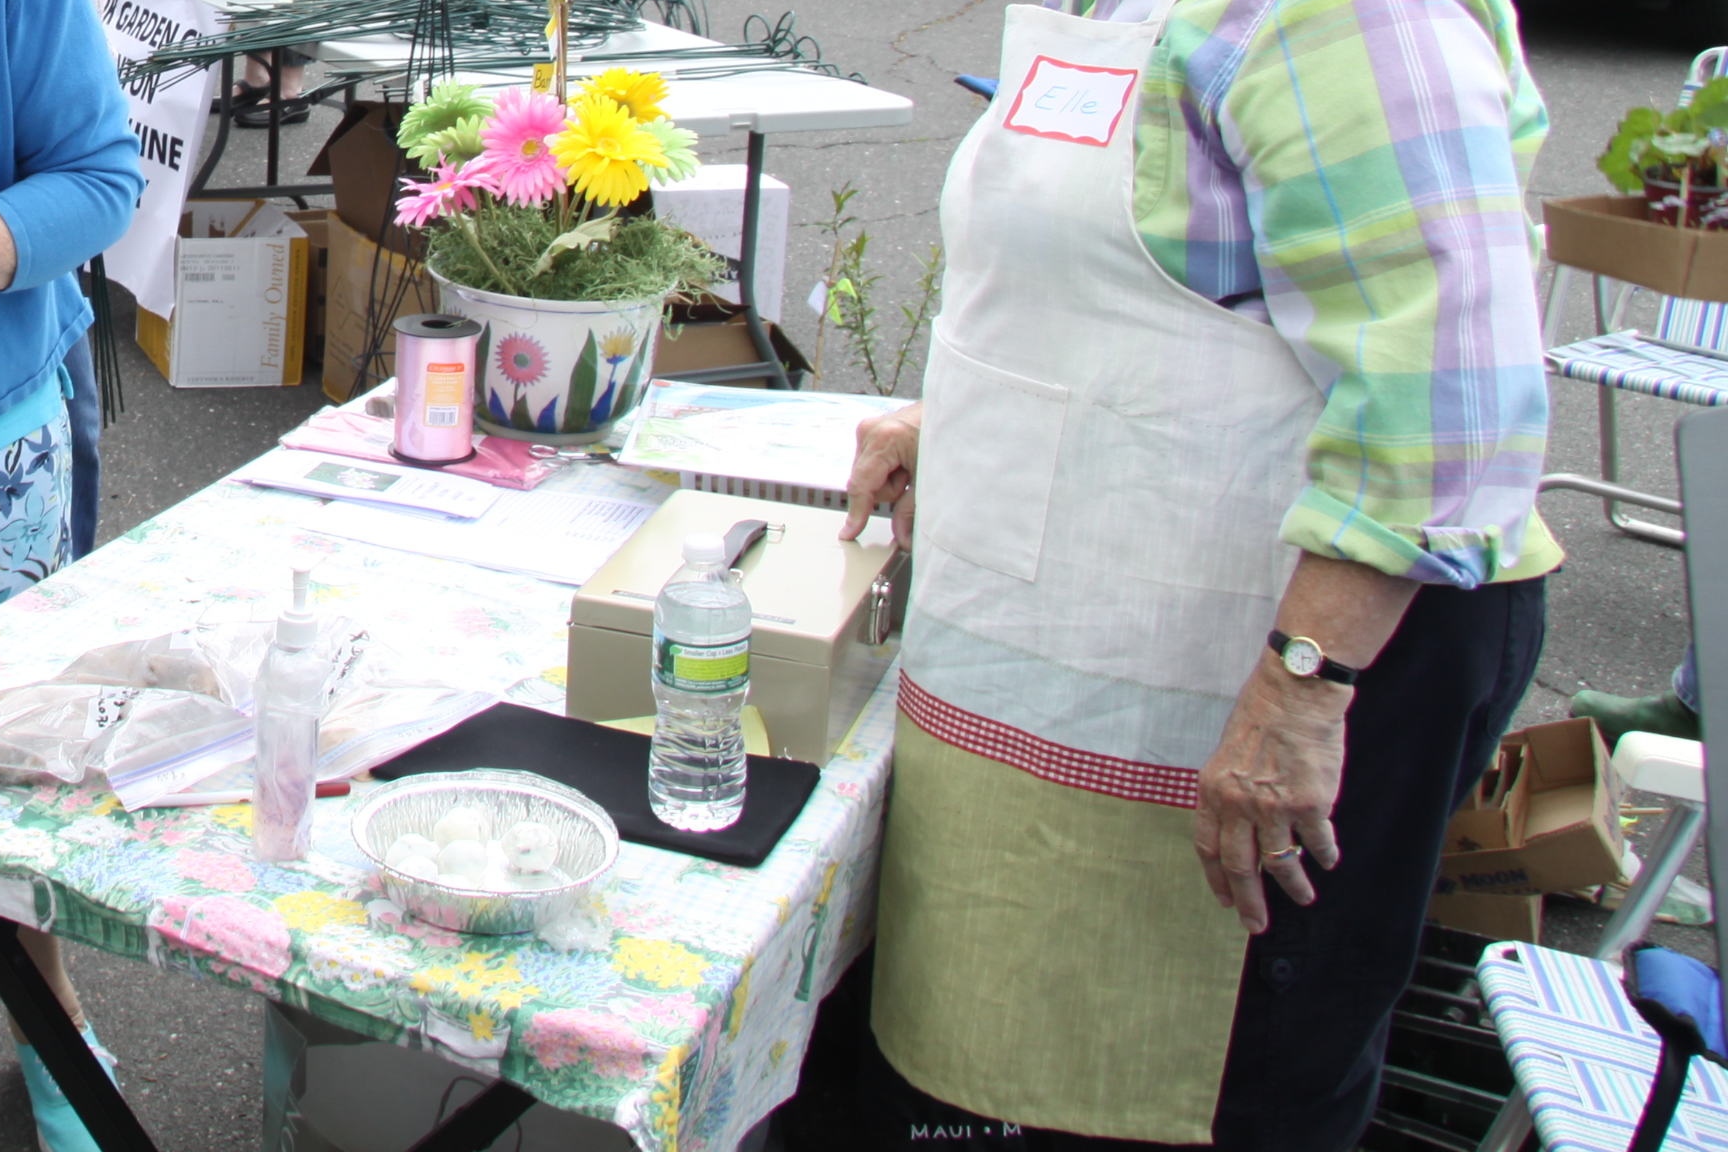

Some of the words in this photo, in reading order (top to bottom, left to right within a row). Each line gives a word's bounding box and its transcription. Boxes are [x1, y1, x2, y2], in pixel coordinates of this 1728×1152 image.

[115, 0, 180, 49] GARDEN
[264, 243, 285, 305] Owned
[260, 312, 287, 368] Family
[1459, 867, 1529, 889] MOON
[910, 1123, 971, 1140] MAUI
